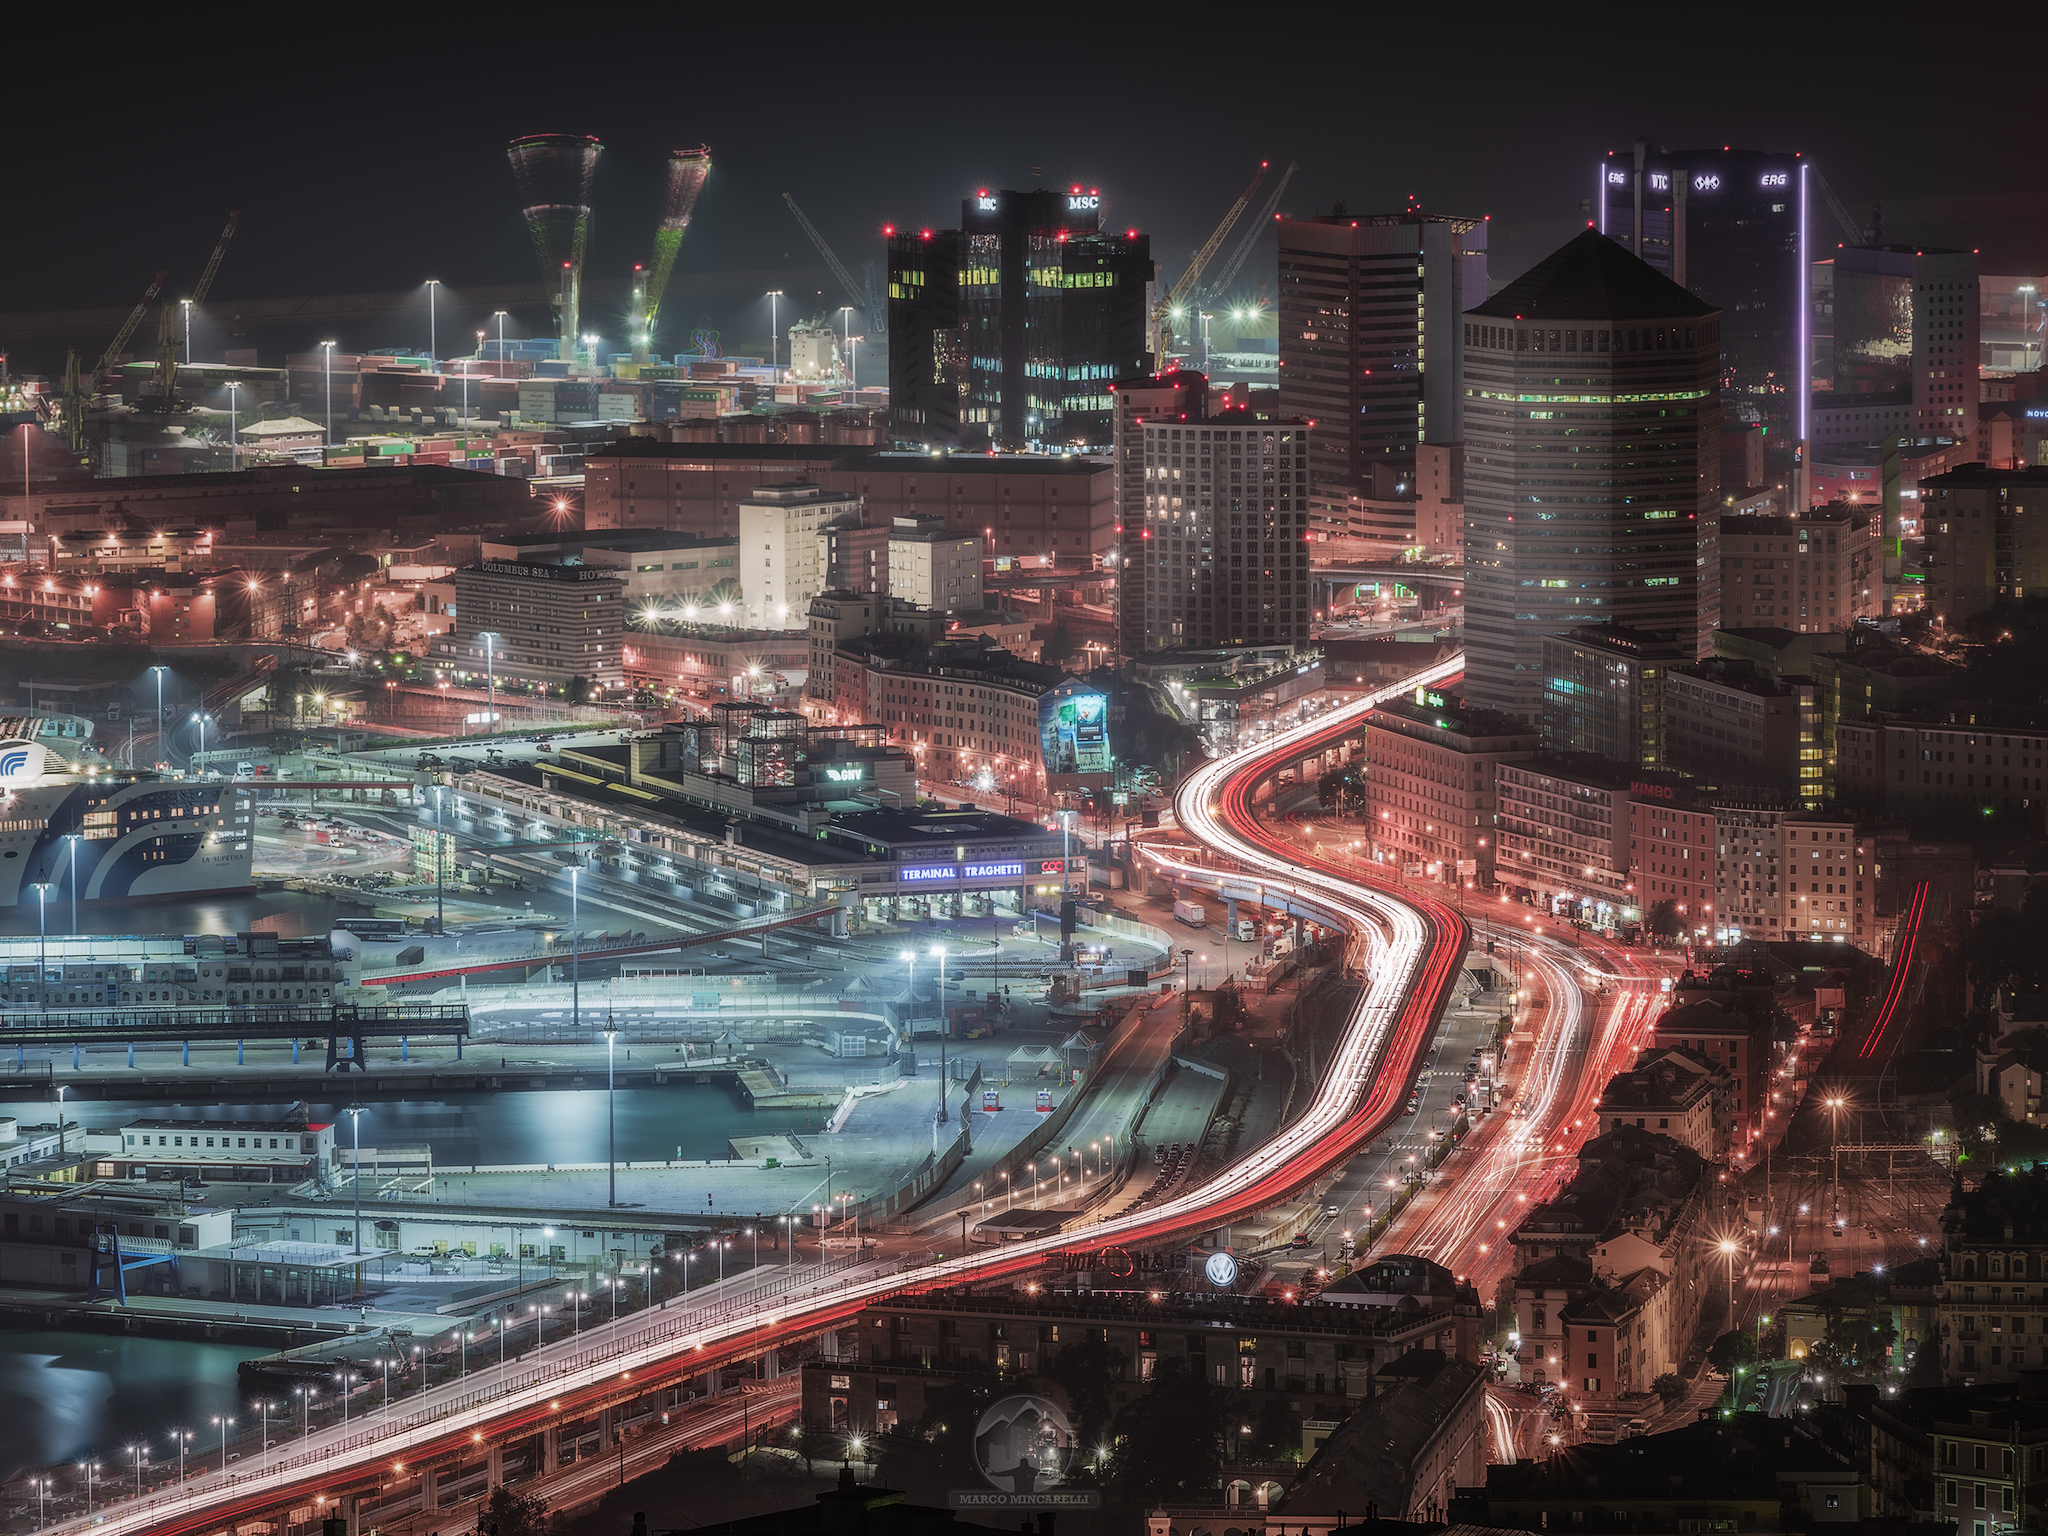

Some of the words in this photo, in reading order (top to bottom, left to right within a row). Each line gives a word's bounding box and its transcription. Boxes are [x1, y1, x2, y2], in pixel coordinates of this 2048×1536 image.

[1608, 172, 1625, 184] ERG
[1651, 174, 1668, 190] WTC
[1761, 174, 1787, 186] ERG
[979, 197, 997, 211] MSC
[1069, 197, 1098, 210] MSC
[482, 562, 529, 576] COLUMBUS
[532, 567, 550, 578] SEA
[579, 569, 617, 580] HOTEL
[841, 769, 862, 781] GNV
[1630, 781, 1673, 799] KIMBO
[903, 868, 956, 880] TERMINAL
[965, 864, 1021, 876] TRAGHETTI
